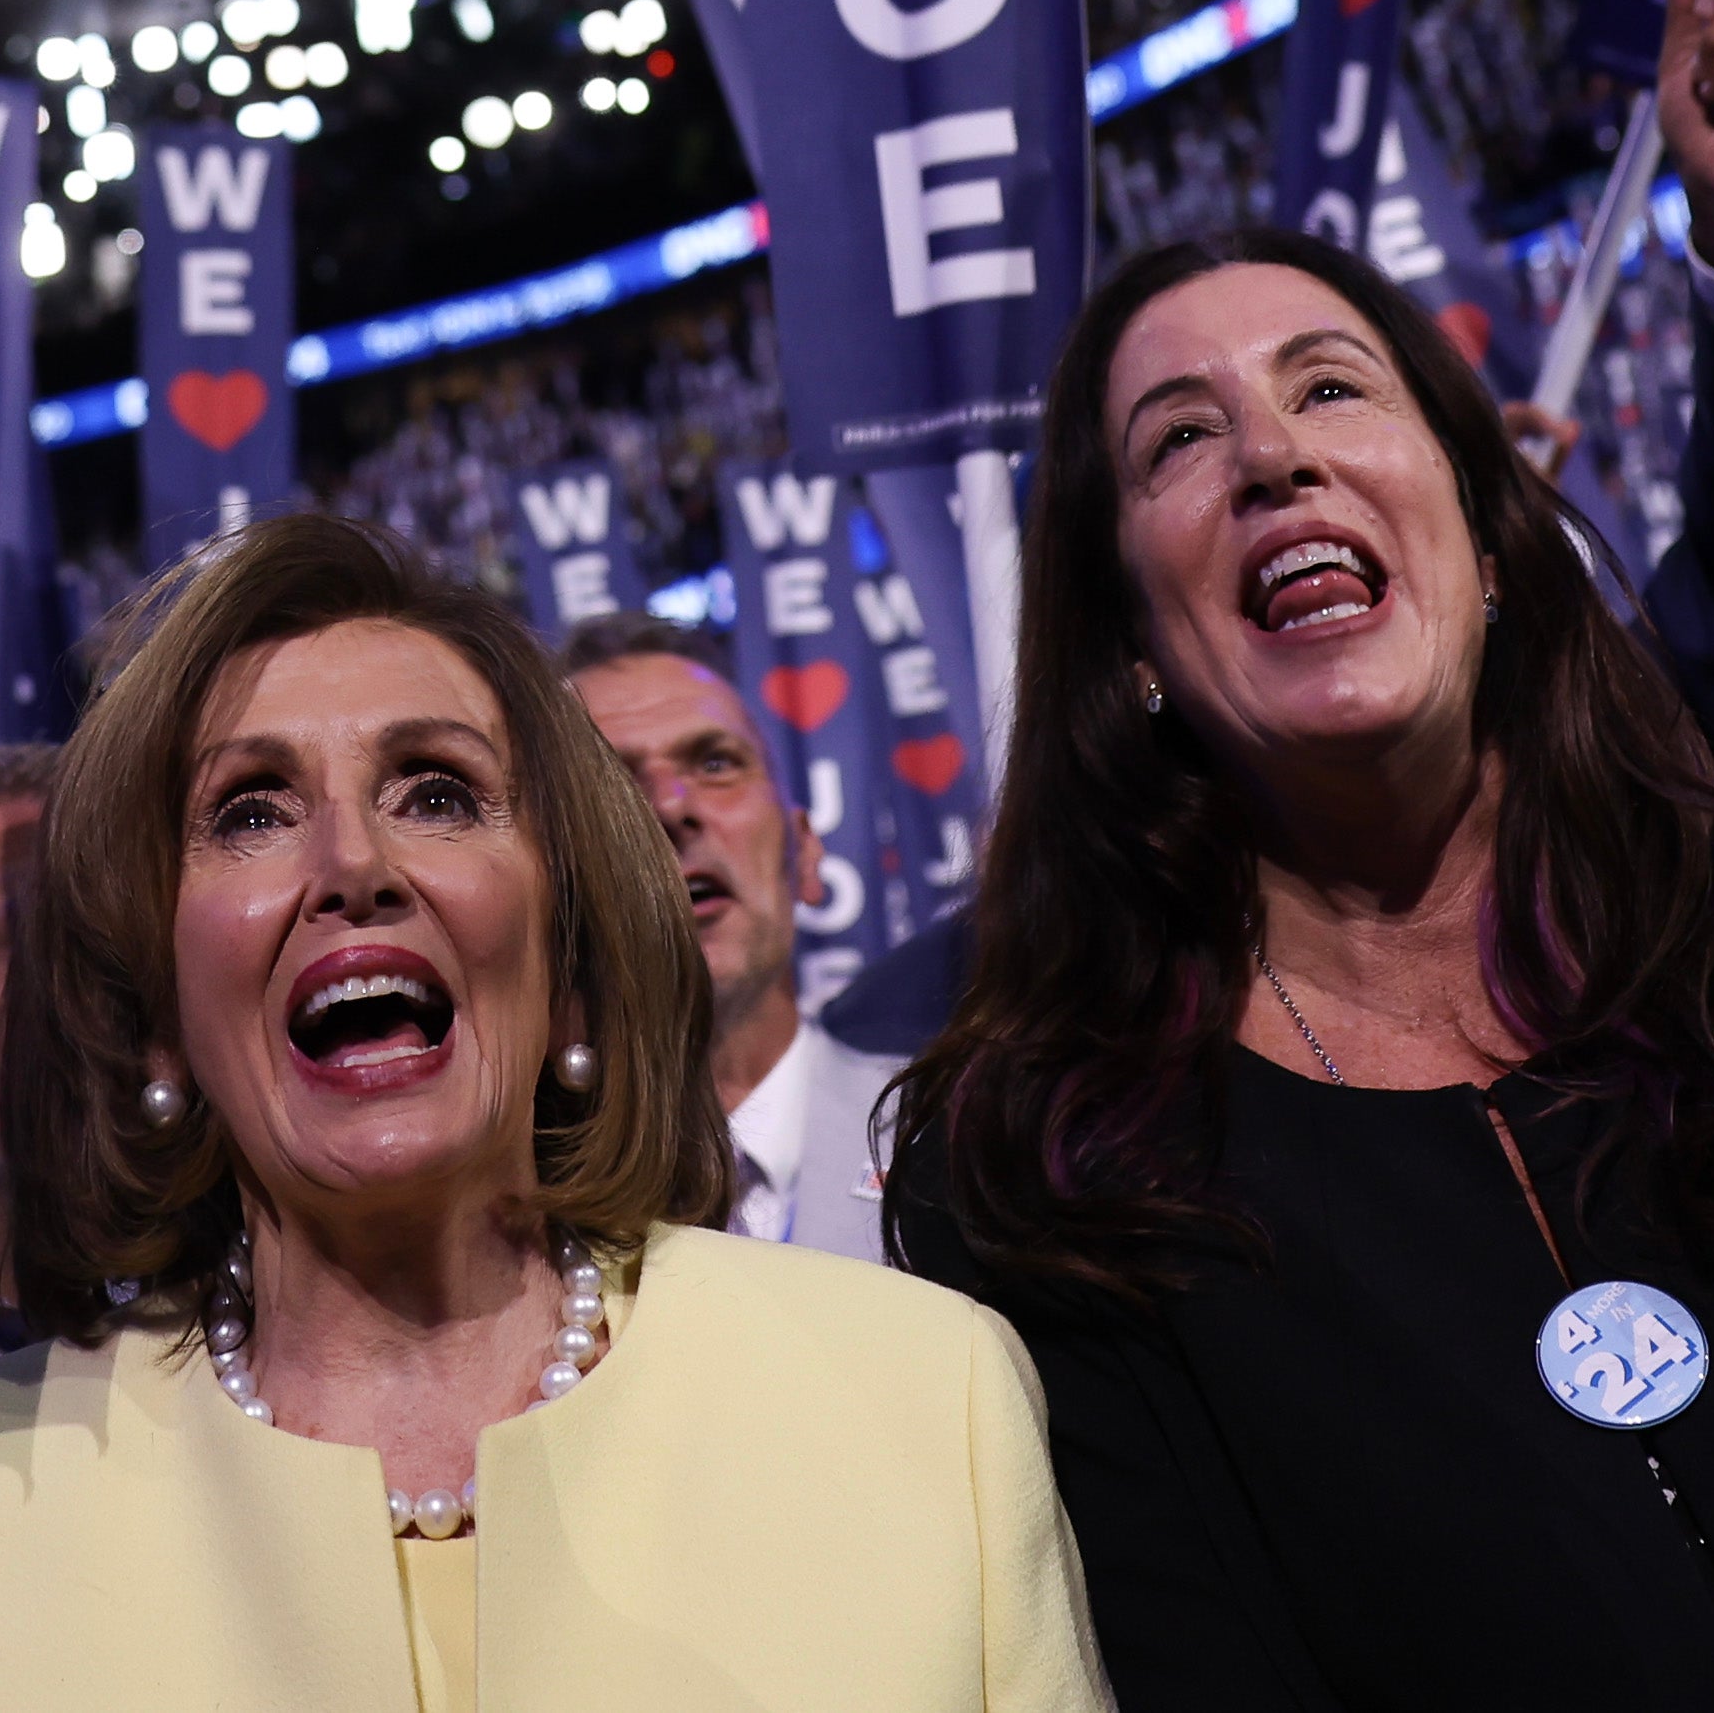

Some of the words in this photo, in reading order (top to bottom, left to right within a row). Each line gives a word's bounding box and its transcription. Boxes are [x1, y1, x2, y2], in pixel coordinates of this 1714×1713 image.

[153, 143, 274, 336] WE
[732, 474, 837, 637] WE
[853, 571, 949, 719] WE
